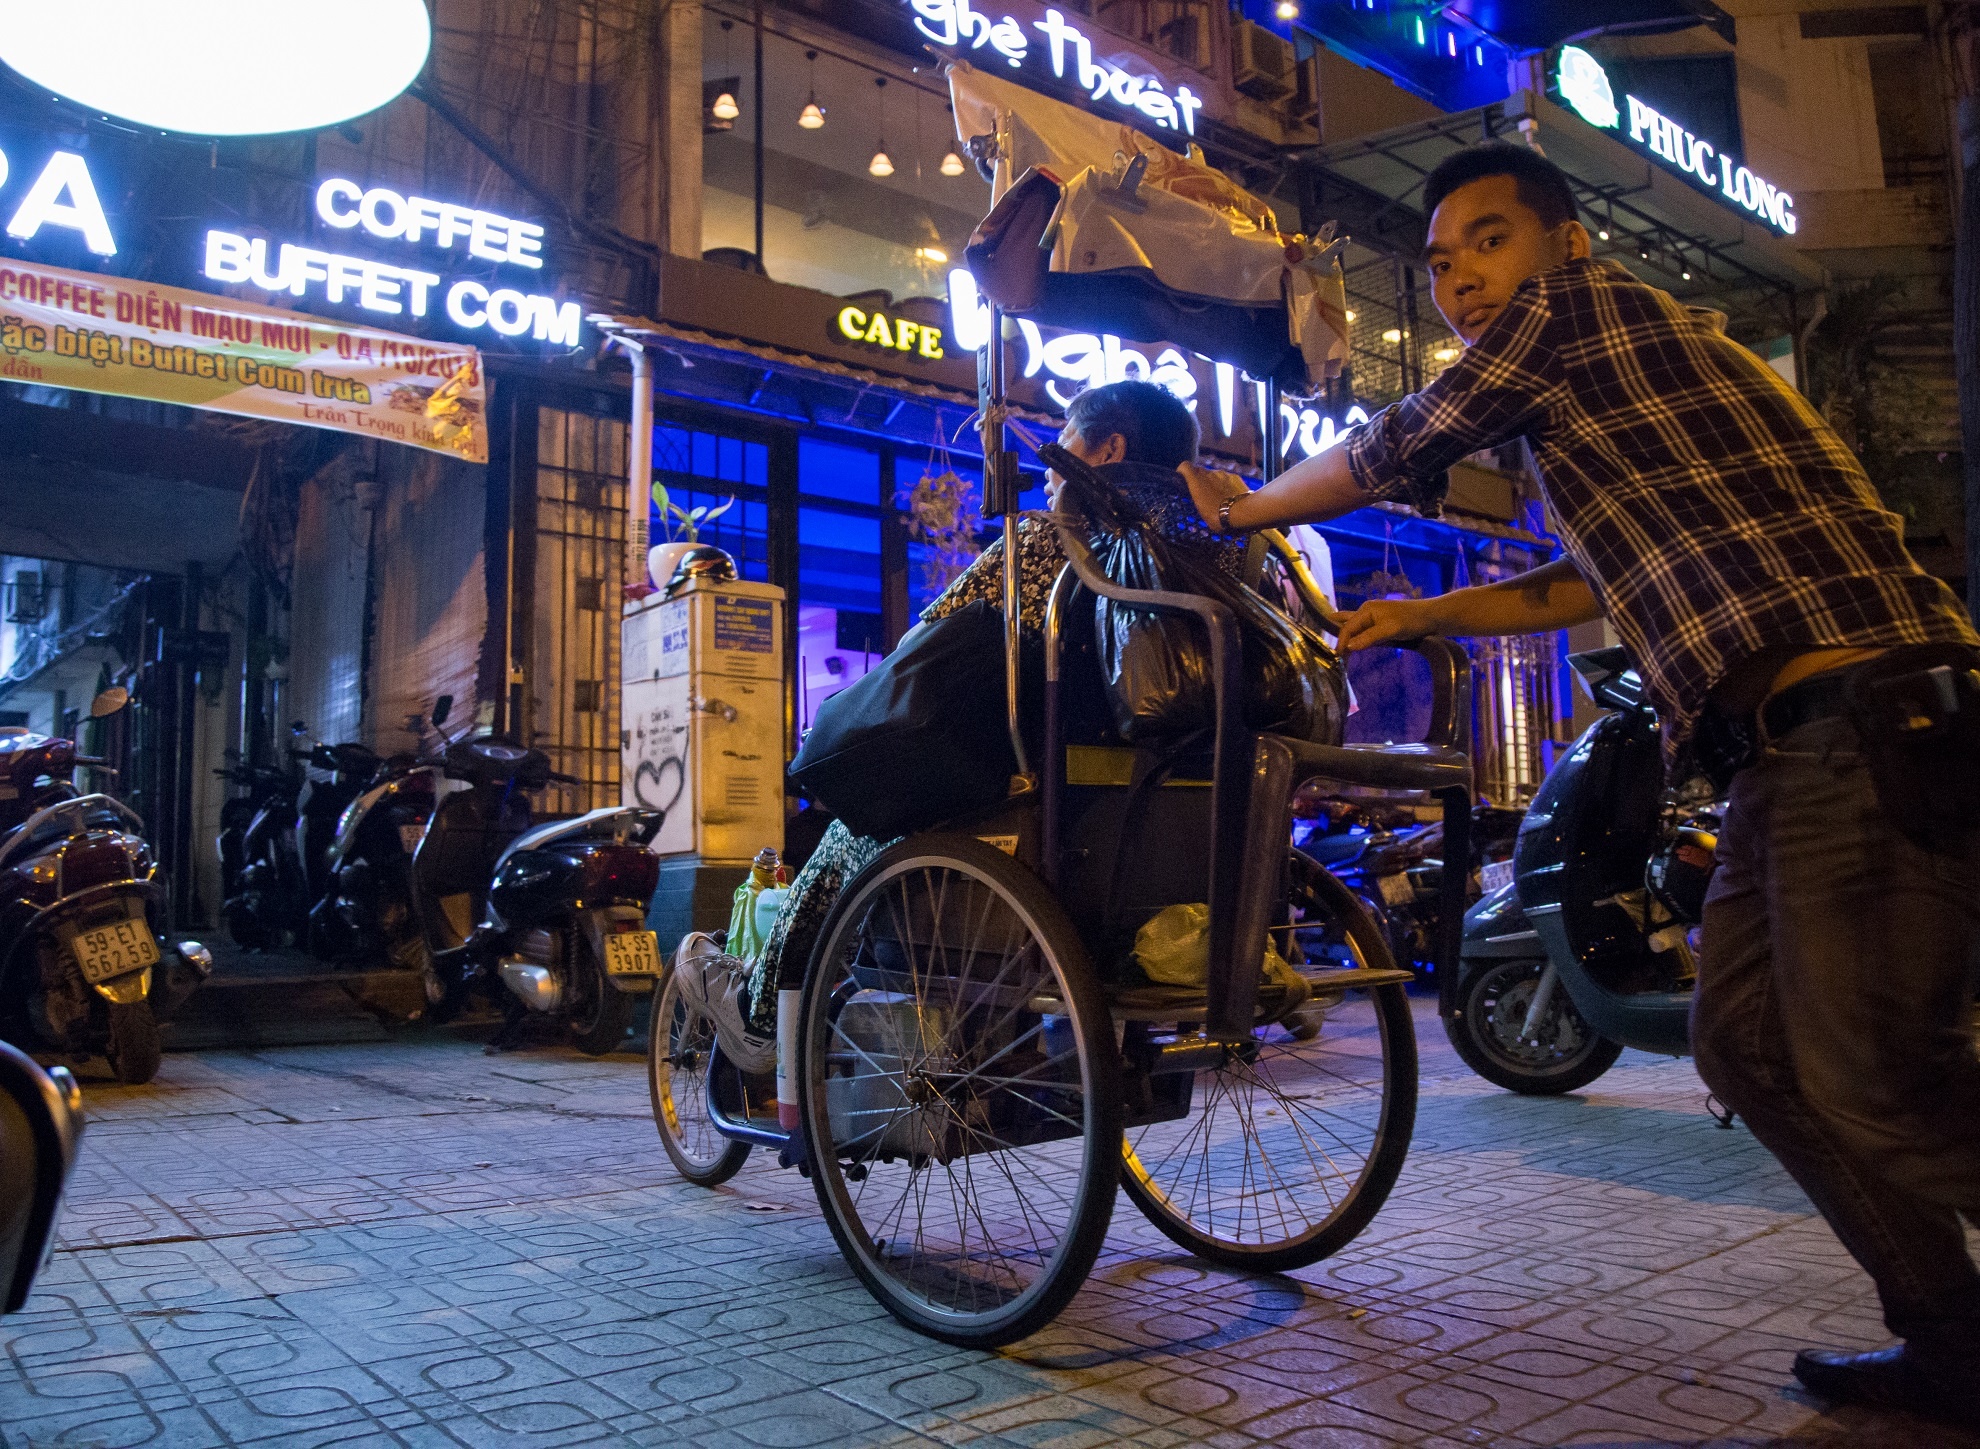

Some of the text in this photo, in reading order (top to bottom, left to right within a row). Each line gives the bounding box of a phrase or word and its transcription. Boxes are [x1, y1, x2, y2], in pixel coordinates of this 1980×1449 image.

[0, 148, 118, 257] A
[1718, 153, 1797, 235] LONG
[316, 178, 544, 269] COFFEE
[0, 269, 106, 318] COFFEE
[205, 229, 440, 317] BUFFET
[0, 315, 372, 405] ặc biệt Buffet Cơm trưa
[838, 306, 944, 360] CAFE
[84, 922, 137, 955] 59-E1
[86, 941, 153, 978] 56259
[610, 935, 649, 952] 54-S5
[614, 953, 651, 971] 3907
